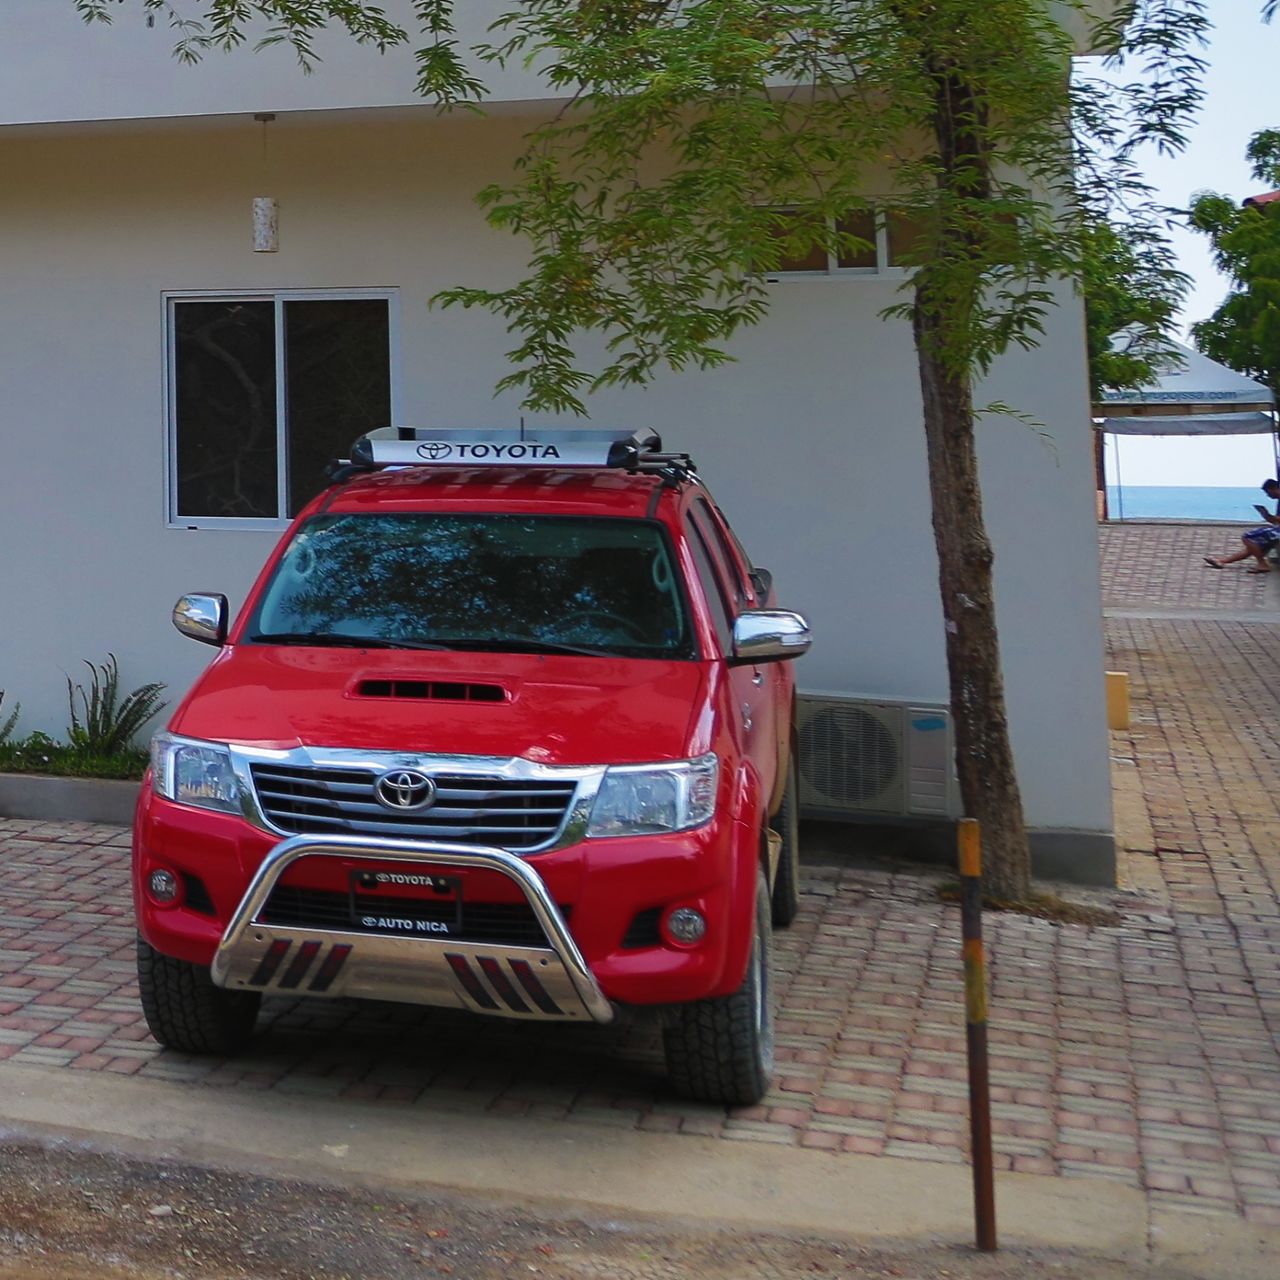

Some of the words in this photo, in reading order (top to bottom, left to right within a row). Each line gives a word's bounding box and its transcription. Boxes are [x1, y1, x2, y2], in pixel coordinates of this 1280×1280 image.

[455, 444, 560, 458] TOYOTA
[389, 873, 434, 886] TOYOTA
[377, 918, 413, 930] AUTO
[416, 920, 449, 933] NICA
